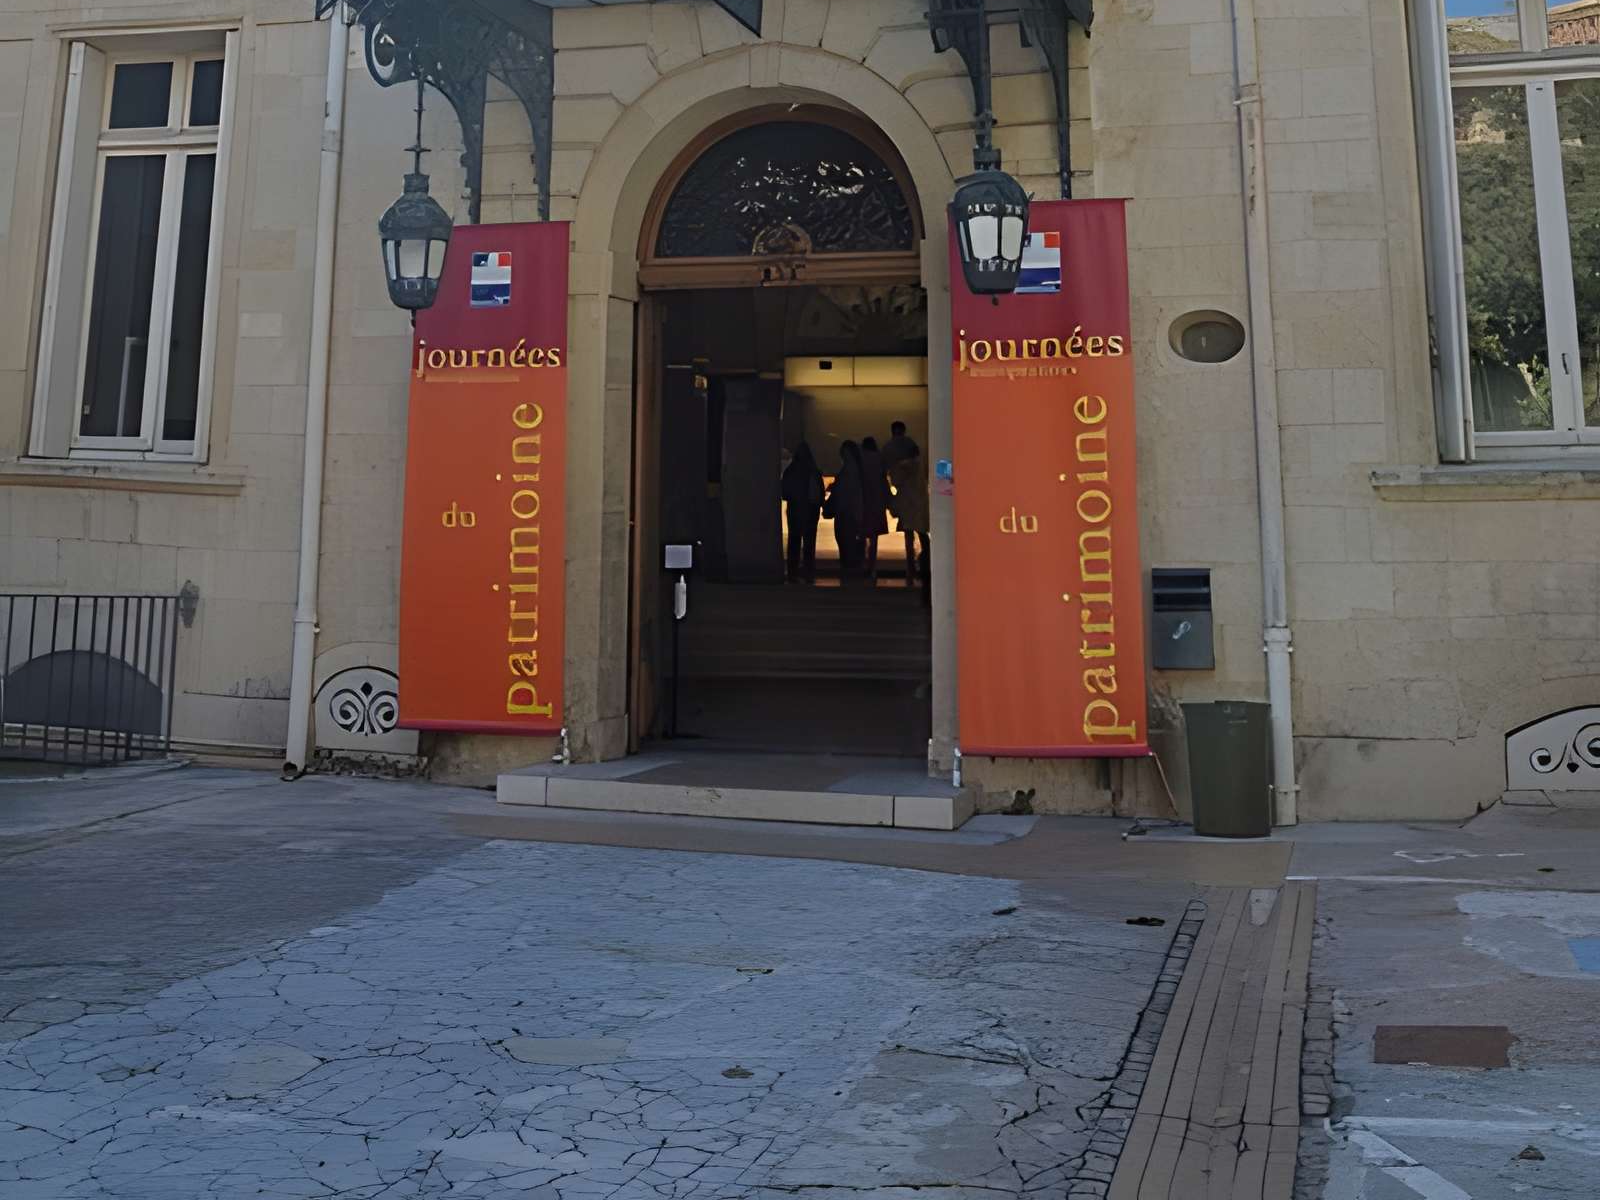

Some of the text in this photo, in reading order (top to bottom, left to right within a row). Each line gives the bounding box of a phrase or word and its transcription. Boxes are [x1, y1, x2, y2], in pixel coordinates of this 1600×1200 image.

[416, 339, 561, 378] journées
[959, 325, 1124, 371] journées
[442, 501, 476, 527] du
[999, 506, 1039, 533] du
[492, 401, 553, 718] patrimoine
[1058, 394, 1136, 743] patrimoine
